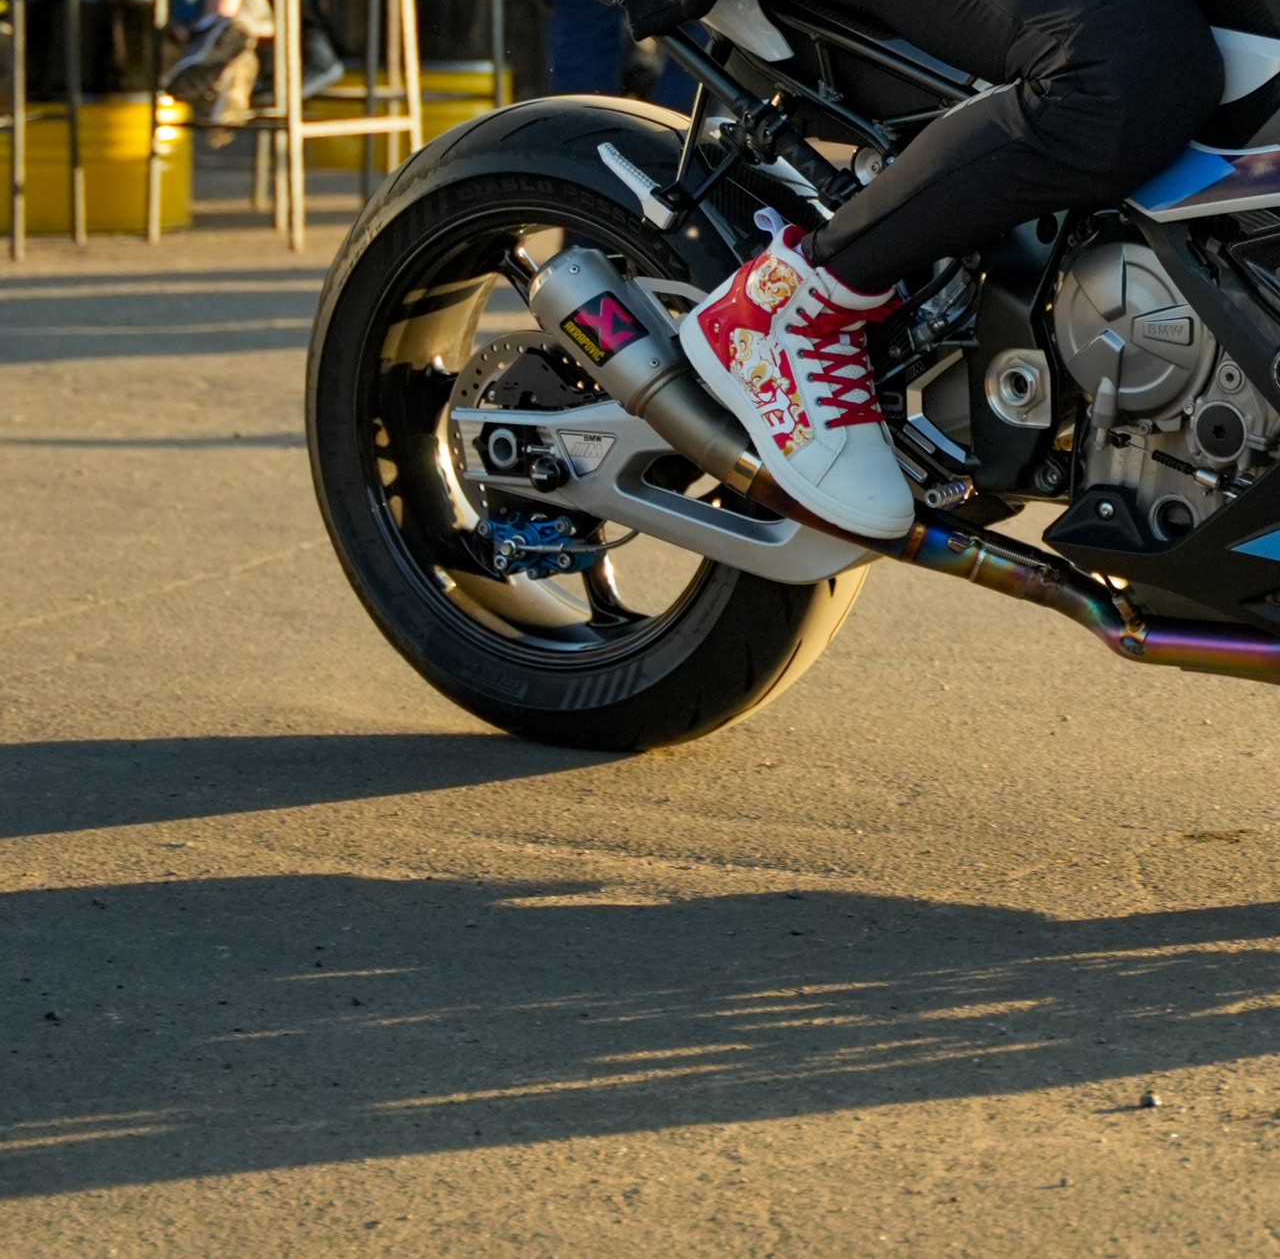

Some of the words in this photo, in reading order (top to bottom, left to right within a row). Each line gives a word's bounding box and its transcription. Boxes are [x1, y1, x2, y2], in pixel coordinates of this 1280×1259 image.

[456, 177, 554, 203] DIABLO
[1147, 323, 1185, 338] BMW
[583, 434, 603, 443] BMW
